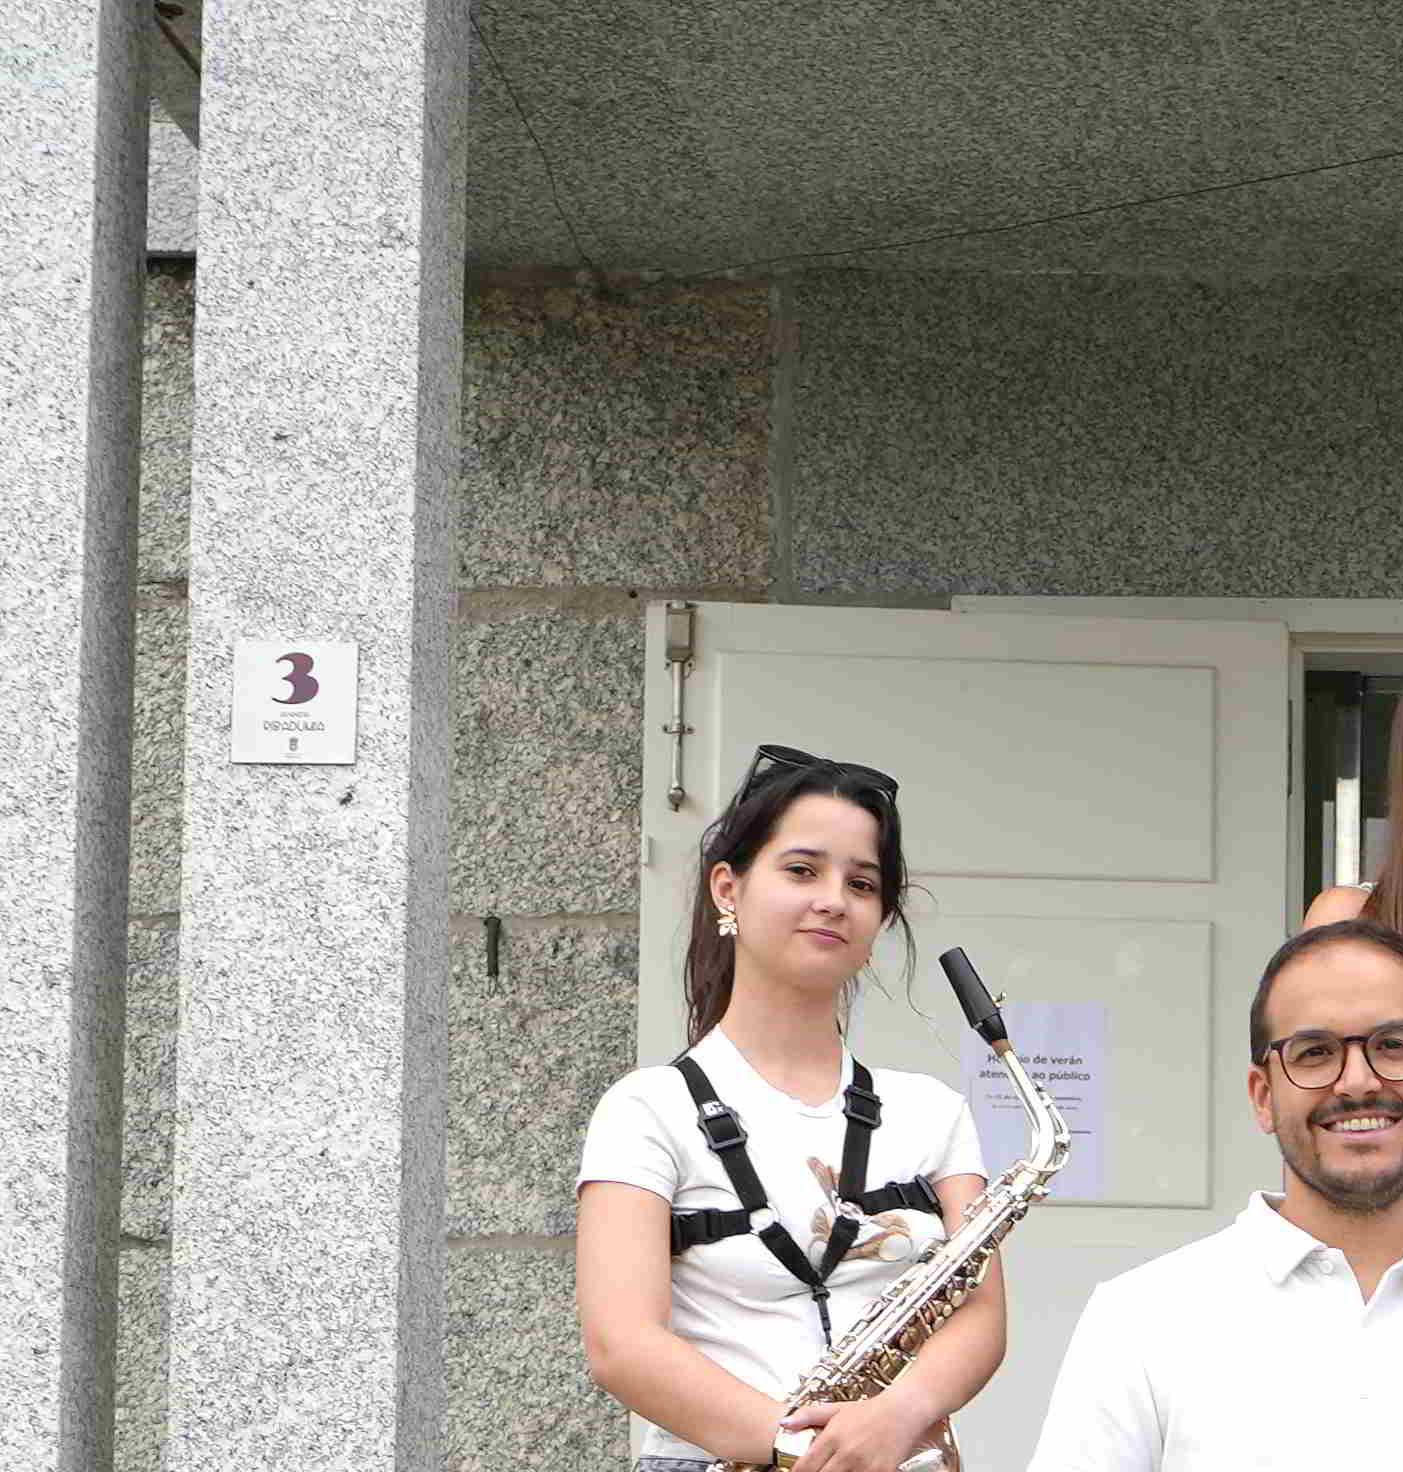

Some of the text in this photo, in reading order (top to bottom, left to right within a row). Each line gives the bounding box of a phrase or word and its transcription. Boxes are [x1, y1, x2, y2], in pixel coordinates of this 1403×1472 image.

[272, 652, 319, 704] 3
[1033, 1055, 1048, 1064] de
[1050, 1055, 1083, 1065] verán
[1031, 1071, 1046, 1080] ao
[1048, 1070, 1091, 1081] público
